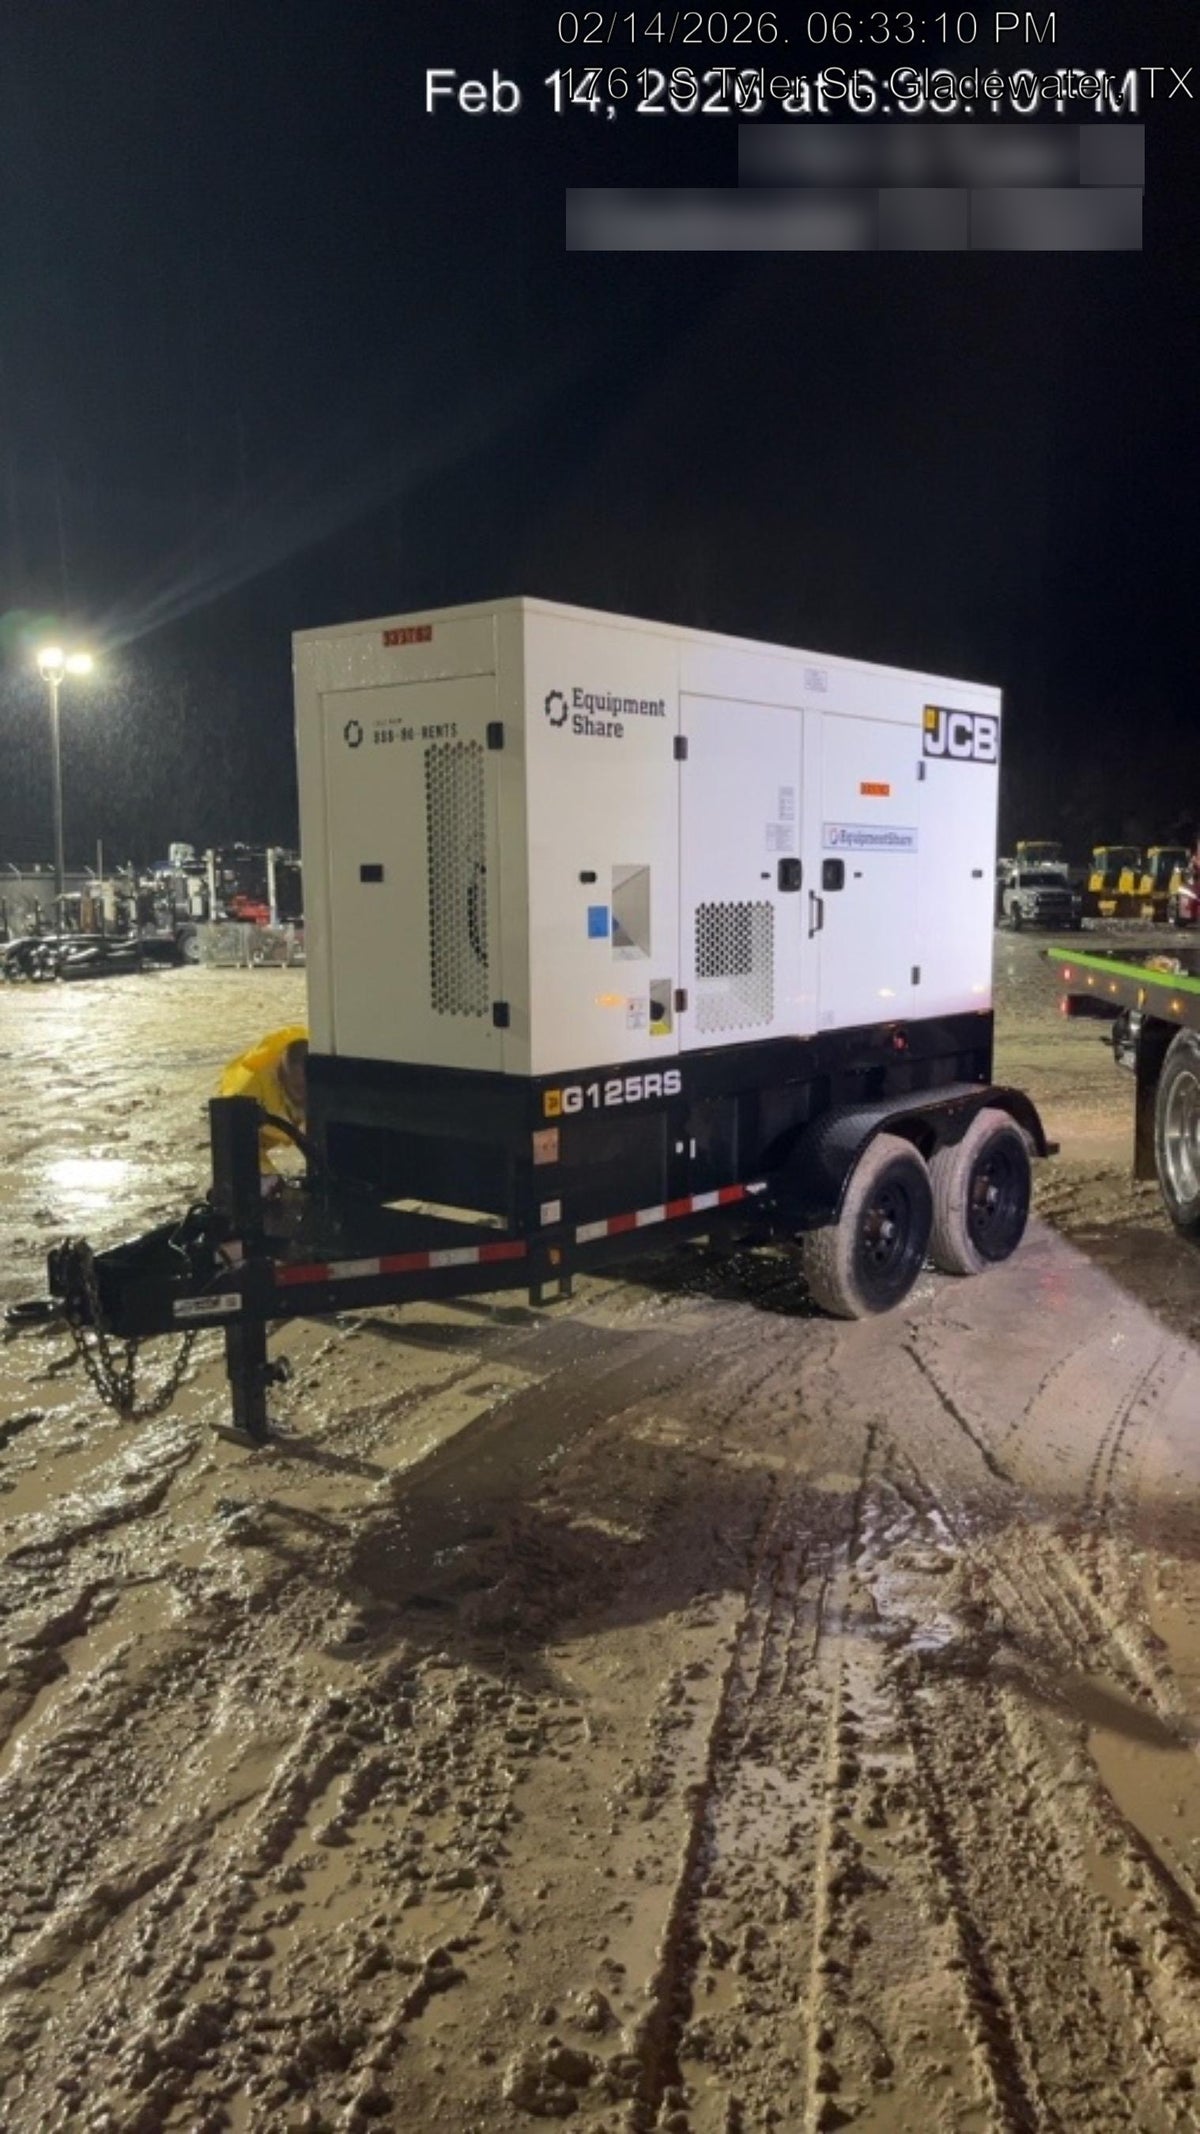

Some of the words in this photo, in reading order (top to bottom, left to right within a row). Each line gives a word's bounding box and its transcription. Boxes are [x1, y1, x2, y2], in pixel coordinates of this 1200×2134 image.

[571, 687, 666, 717] Equipment
[572, 713, 624, 738] Share
[924, 709, 998, 761] JCB
[562, 1069, 682, 1114] G125RS
